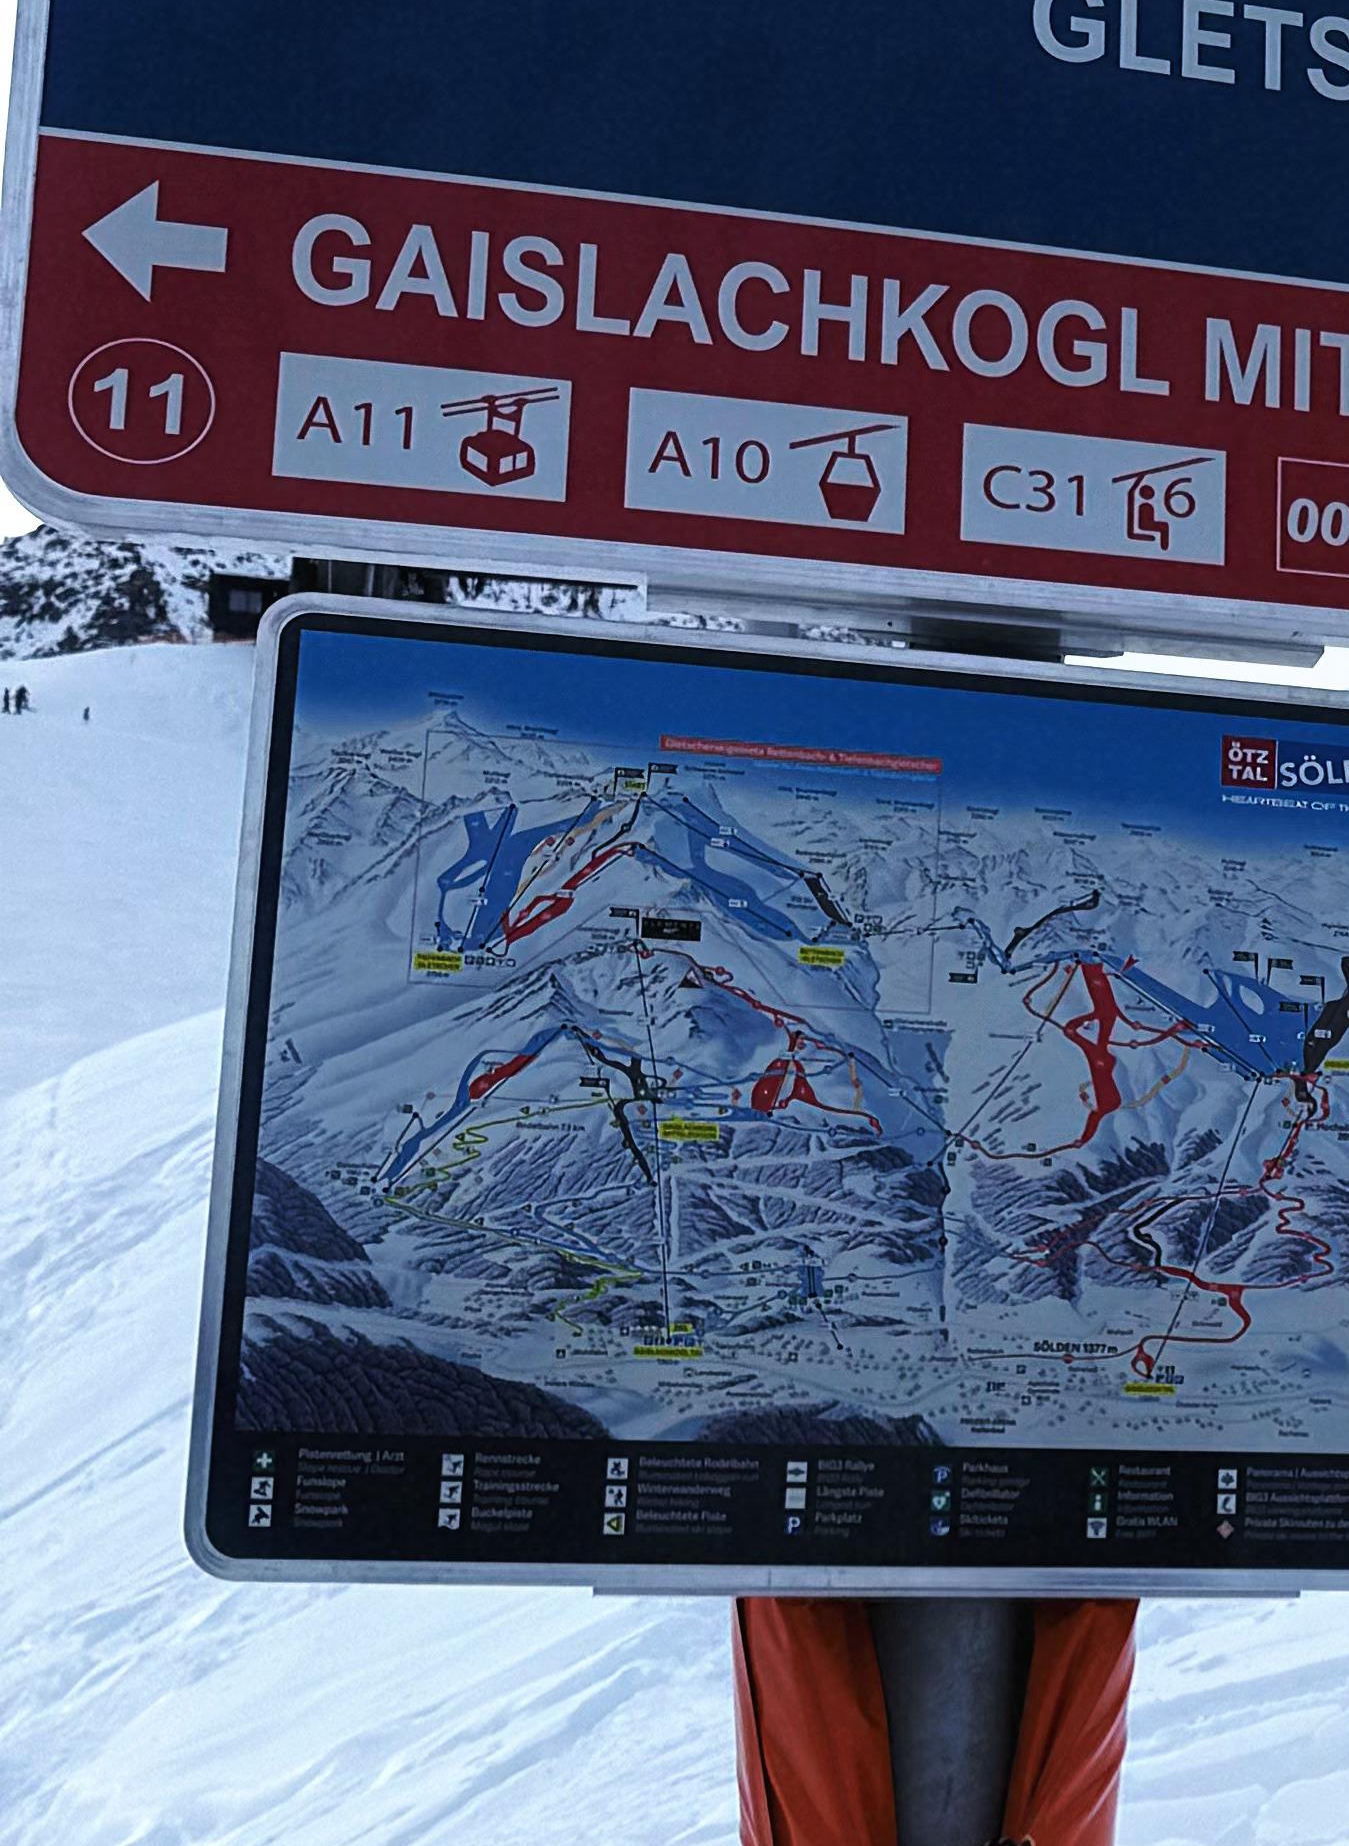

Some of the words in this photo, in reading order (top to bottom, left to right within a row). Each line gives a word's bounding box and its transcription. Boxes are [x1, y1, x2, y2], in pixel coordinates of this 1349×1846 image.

[291, 213, 1170, 397] GAISLACHKOGL
[93, 367, 185, 435] 11
[296, 395, 413, 450] A11
[648, 430, 770, 484] A10
[983, 465, 1086, 517] C31
[1228, 741, 1269, 764] ÖTZ
[1228, 765, 1268, 782] TAL
[1034, 1340, 1080, 1353] SÖLDEN
[1083, 1343, 1106, 1354] 1377
